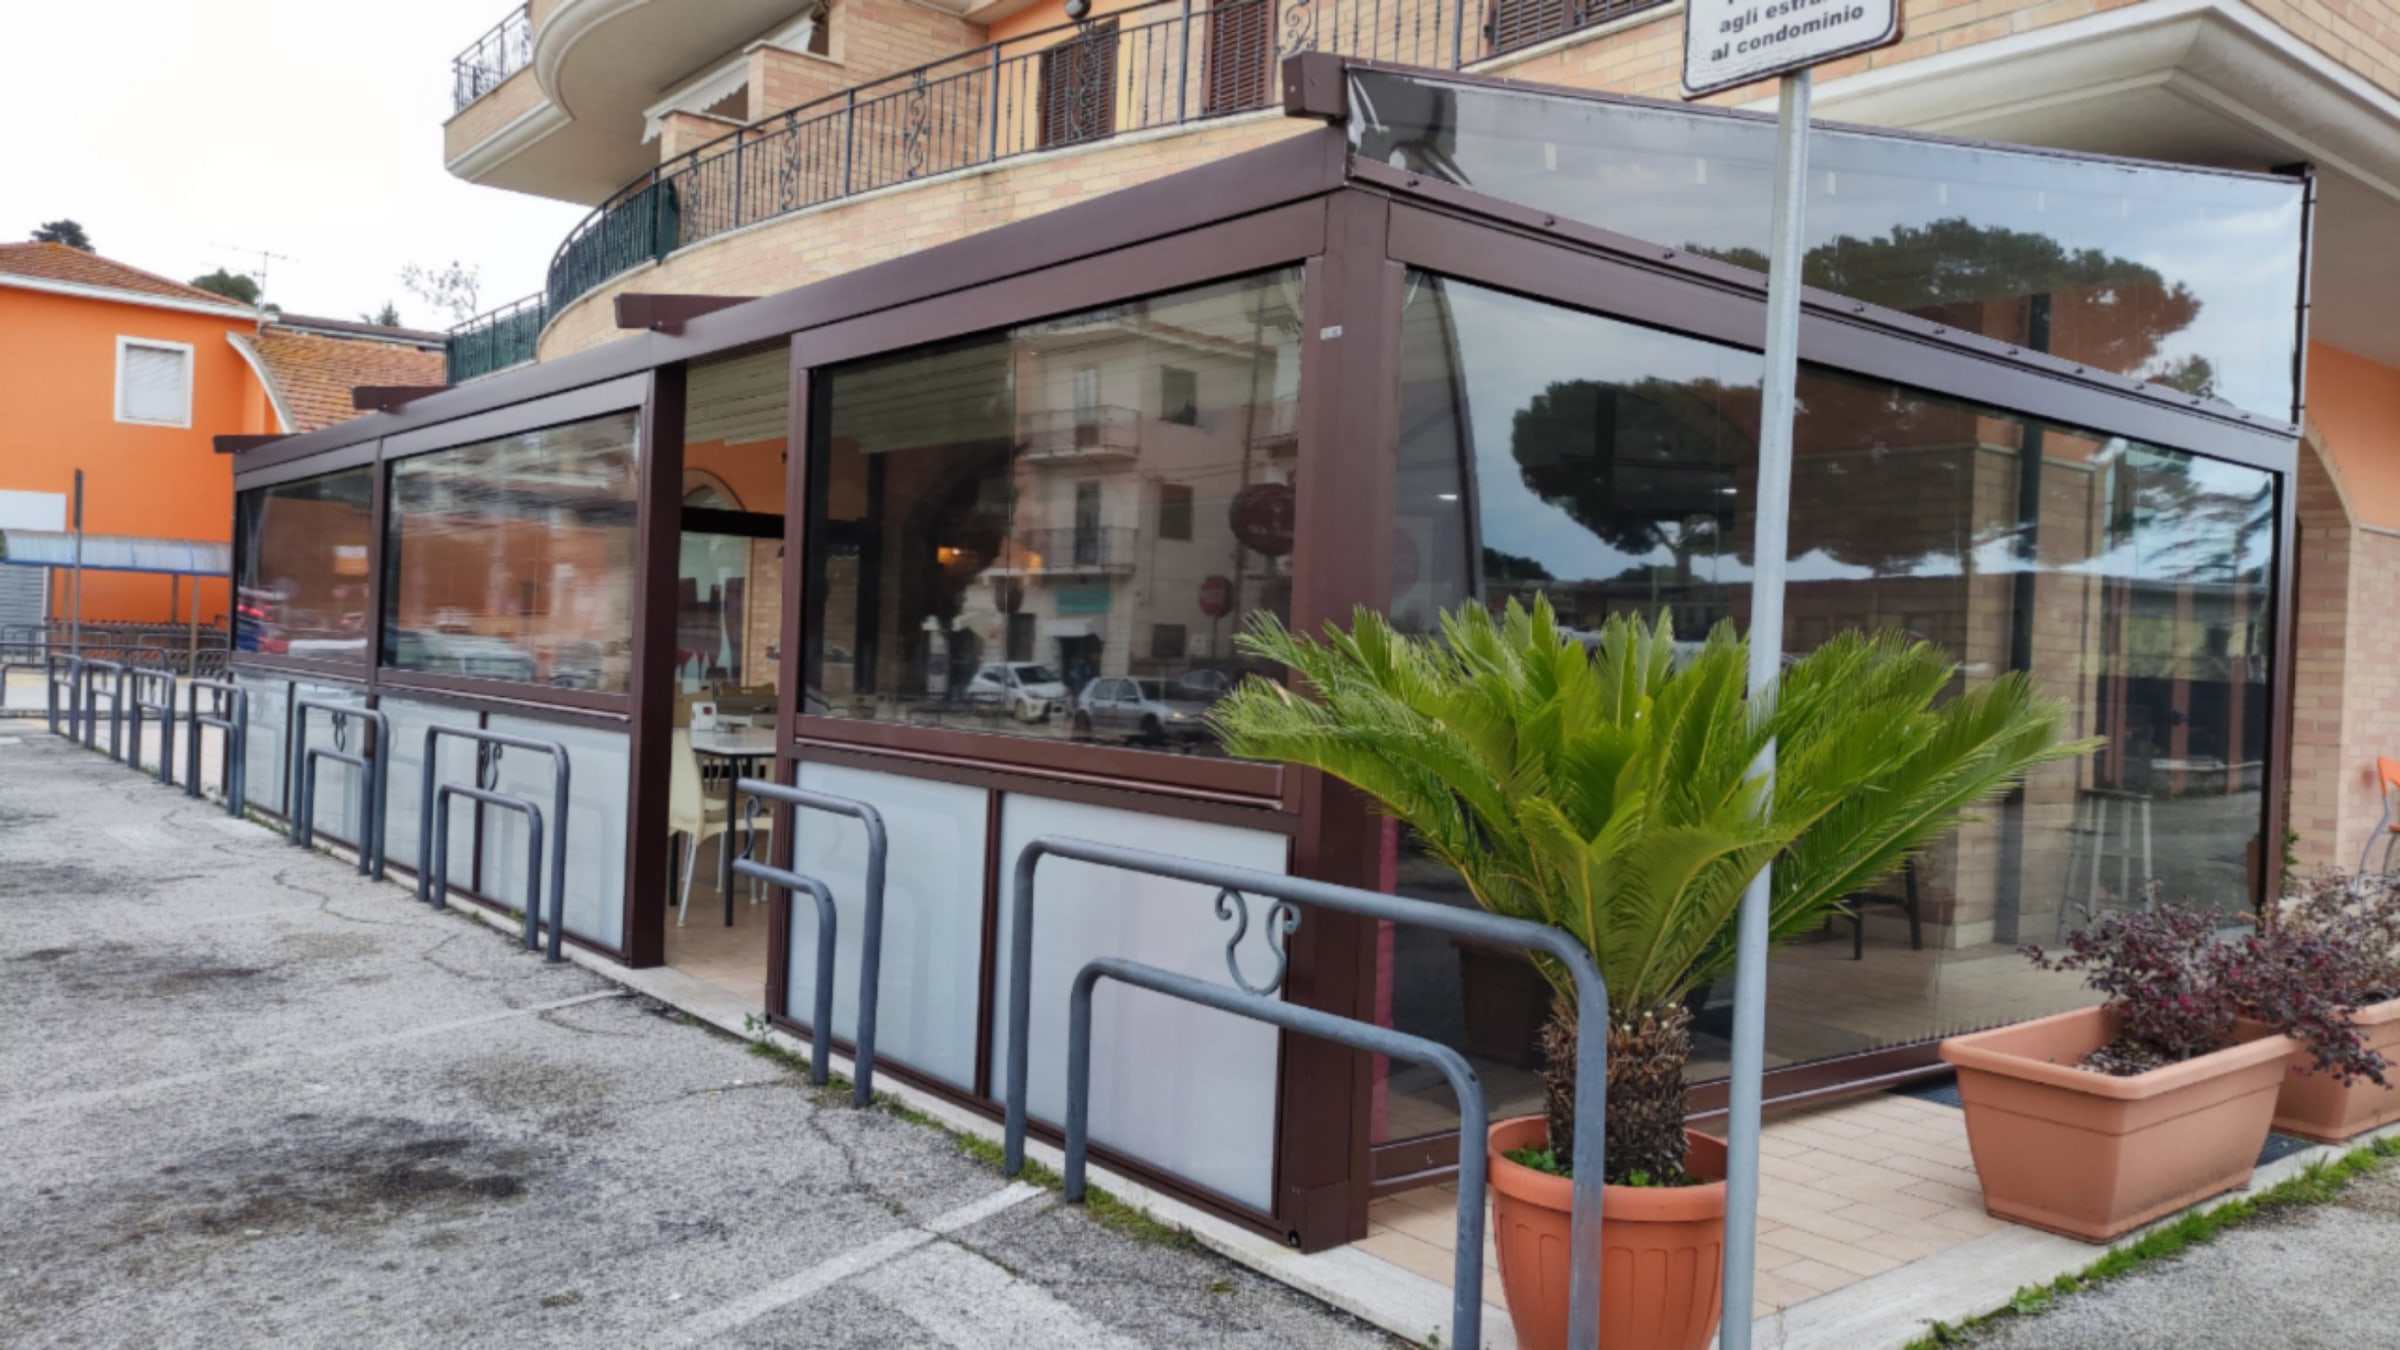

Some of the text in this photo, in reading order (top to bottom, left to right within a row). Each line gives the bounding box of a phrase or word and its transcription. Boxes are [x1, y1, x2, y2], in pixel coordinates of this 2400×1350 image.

[1711, 5, 1864, 61] al condominio
[1719, 7, 1758, 33] agli
